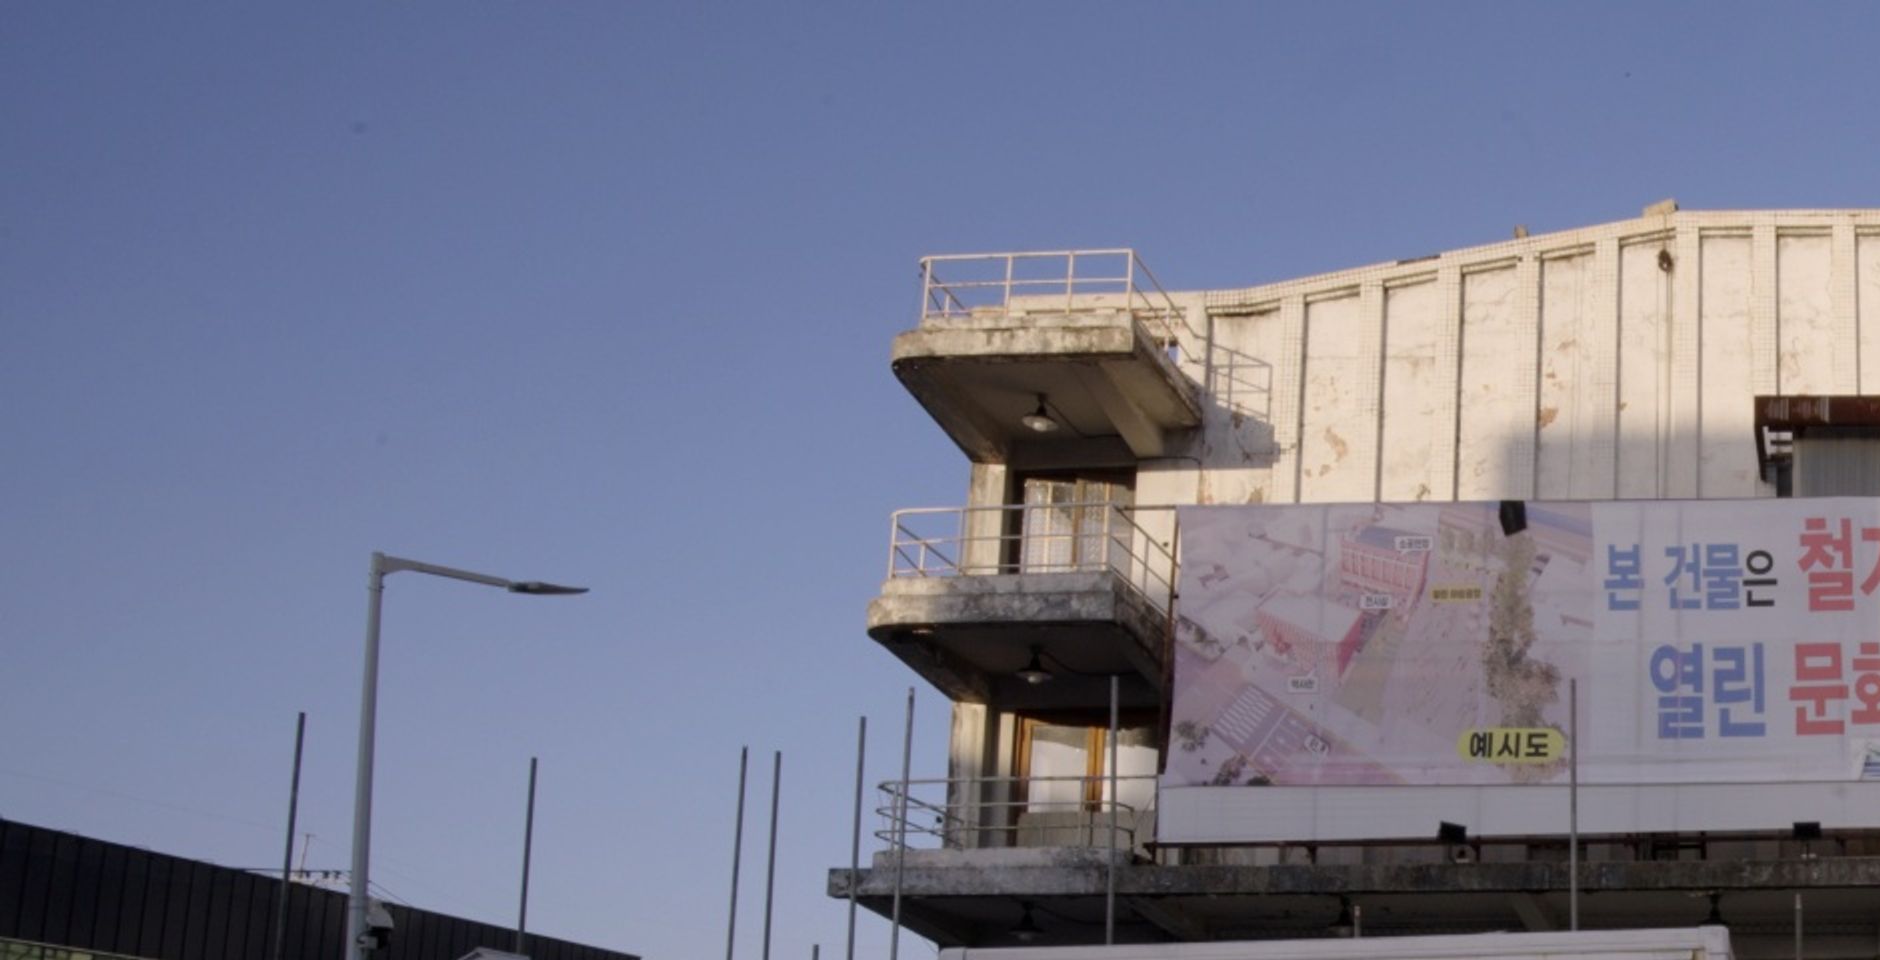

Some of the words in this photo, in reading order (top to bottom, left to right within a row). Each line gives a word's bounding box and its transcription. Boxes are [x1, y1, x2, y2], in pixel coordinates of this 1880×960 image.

[1604, 543, 1645, 611] 본
[1664, 541, 1778, 611] 건물은
[1649, 641, 1767, 739] 열린
[1469, 731, 1550, 759] 예시도
